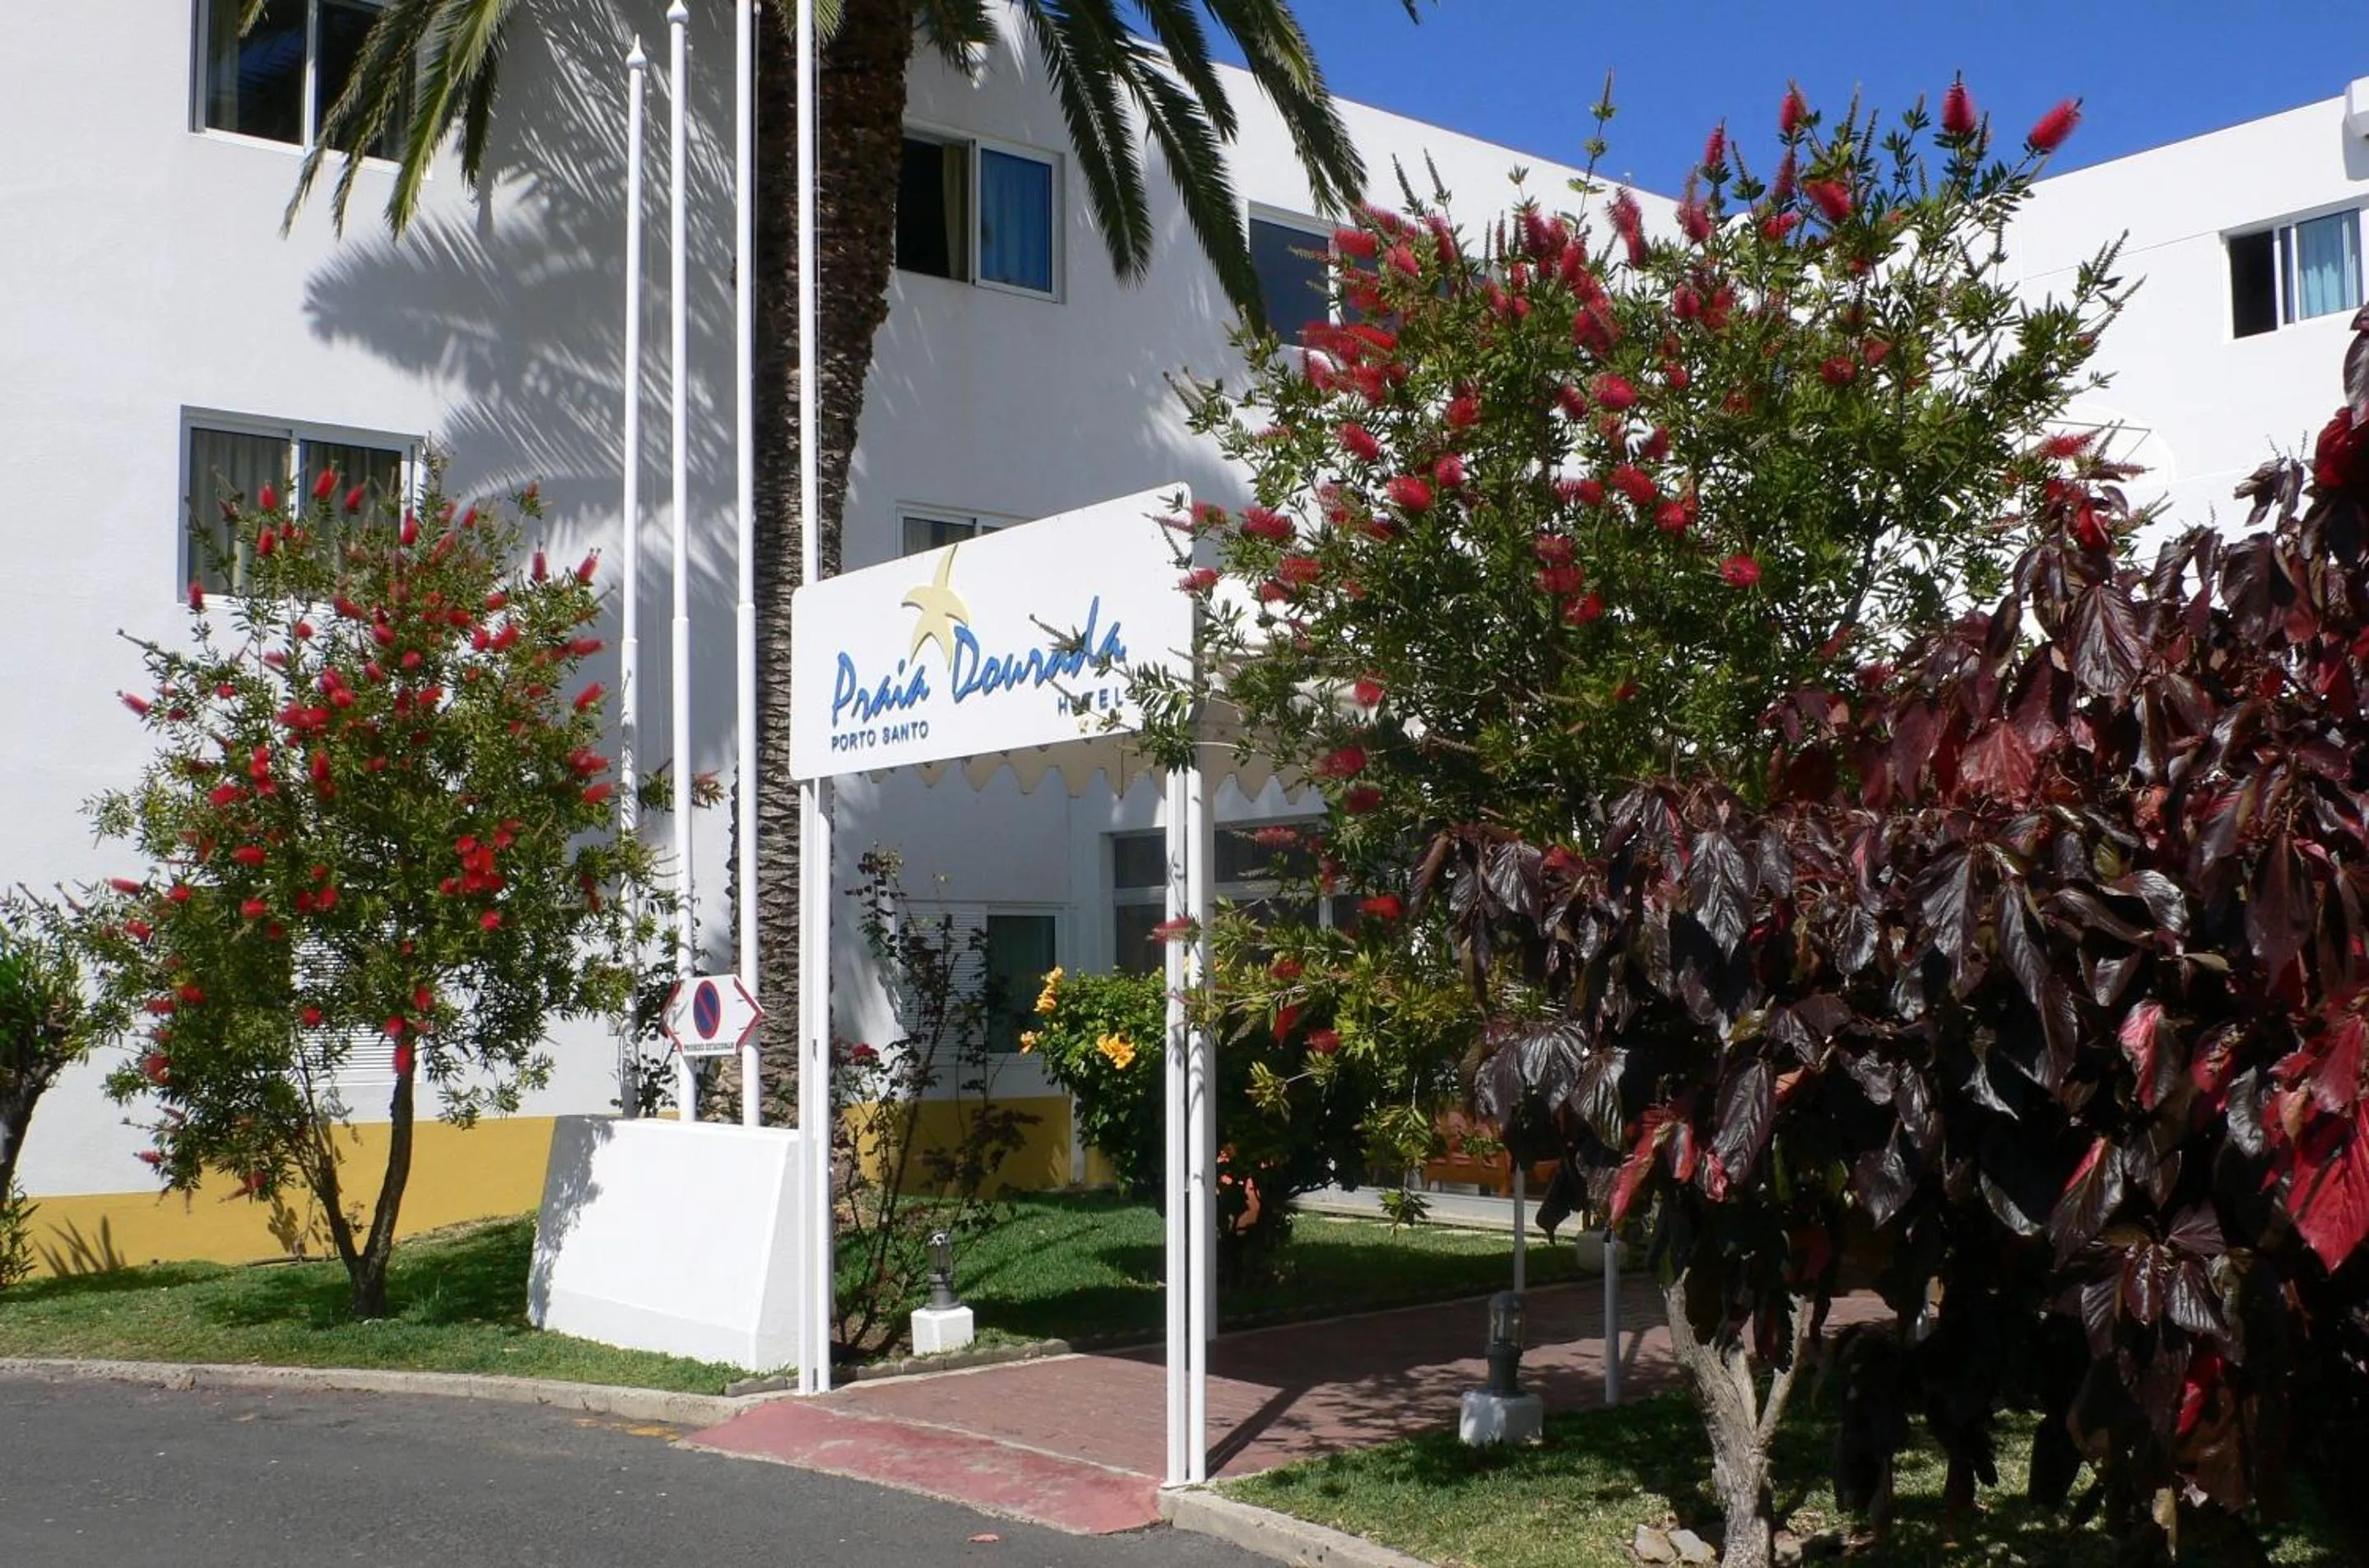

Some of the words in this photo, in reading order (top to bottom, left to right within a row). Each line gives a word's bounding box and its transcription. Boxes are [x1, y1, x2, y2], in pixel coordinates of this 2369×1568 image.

[832, 652, 931, 727] Praia
[951, 595, 1126, 704] Dourada
[1057, 687, 1123, 716] HTEL
[831, 729, 876, 753] PORTO
[882, 720, 930, 745] SANTO
